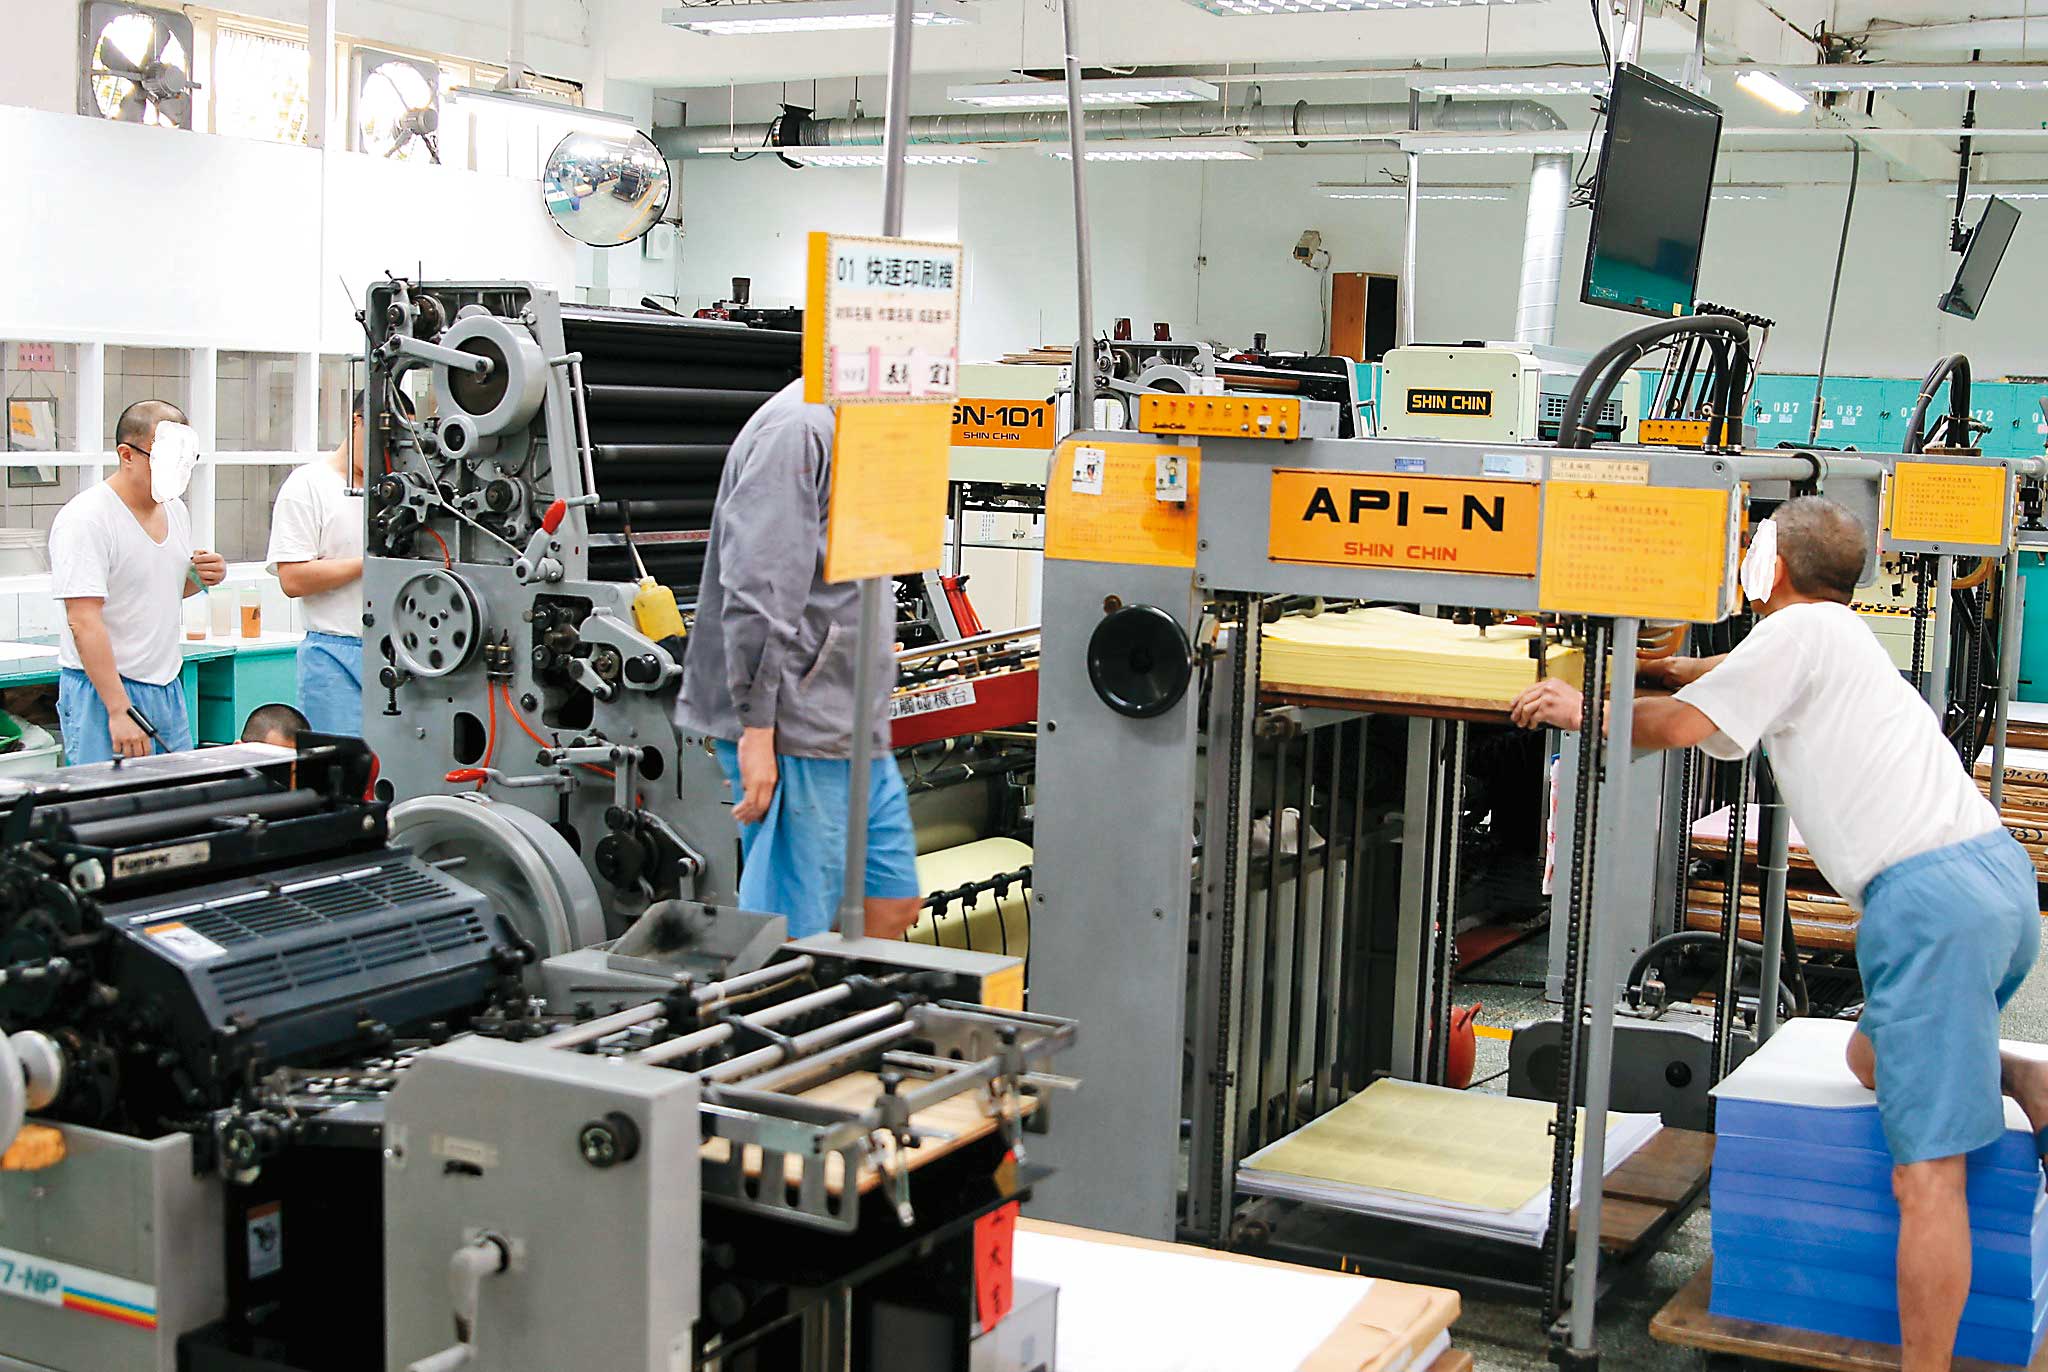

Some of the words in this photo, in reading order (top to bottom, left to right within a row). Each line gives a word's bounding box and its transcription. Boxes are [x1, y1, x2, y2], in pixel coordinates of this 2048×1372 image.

[837, 257, 854, 283] 01
[867, 256, 953, 289] 快速印刷機
[1411, 394, 1447, 410] SHIN
[1451, 395, 1487, 411] CHIN
[1773, 402, 1800, 414] 087
[1836, 405, 1863, 417] 082
[1969, 409, 1995, 422] 72
[963, 431, 990, 440] SHIN
[992, 432, 1020, 441] CHIN
[1344, 542, 1394, 558] SHIN
[1406, 545, 1458, 562] CHIN
